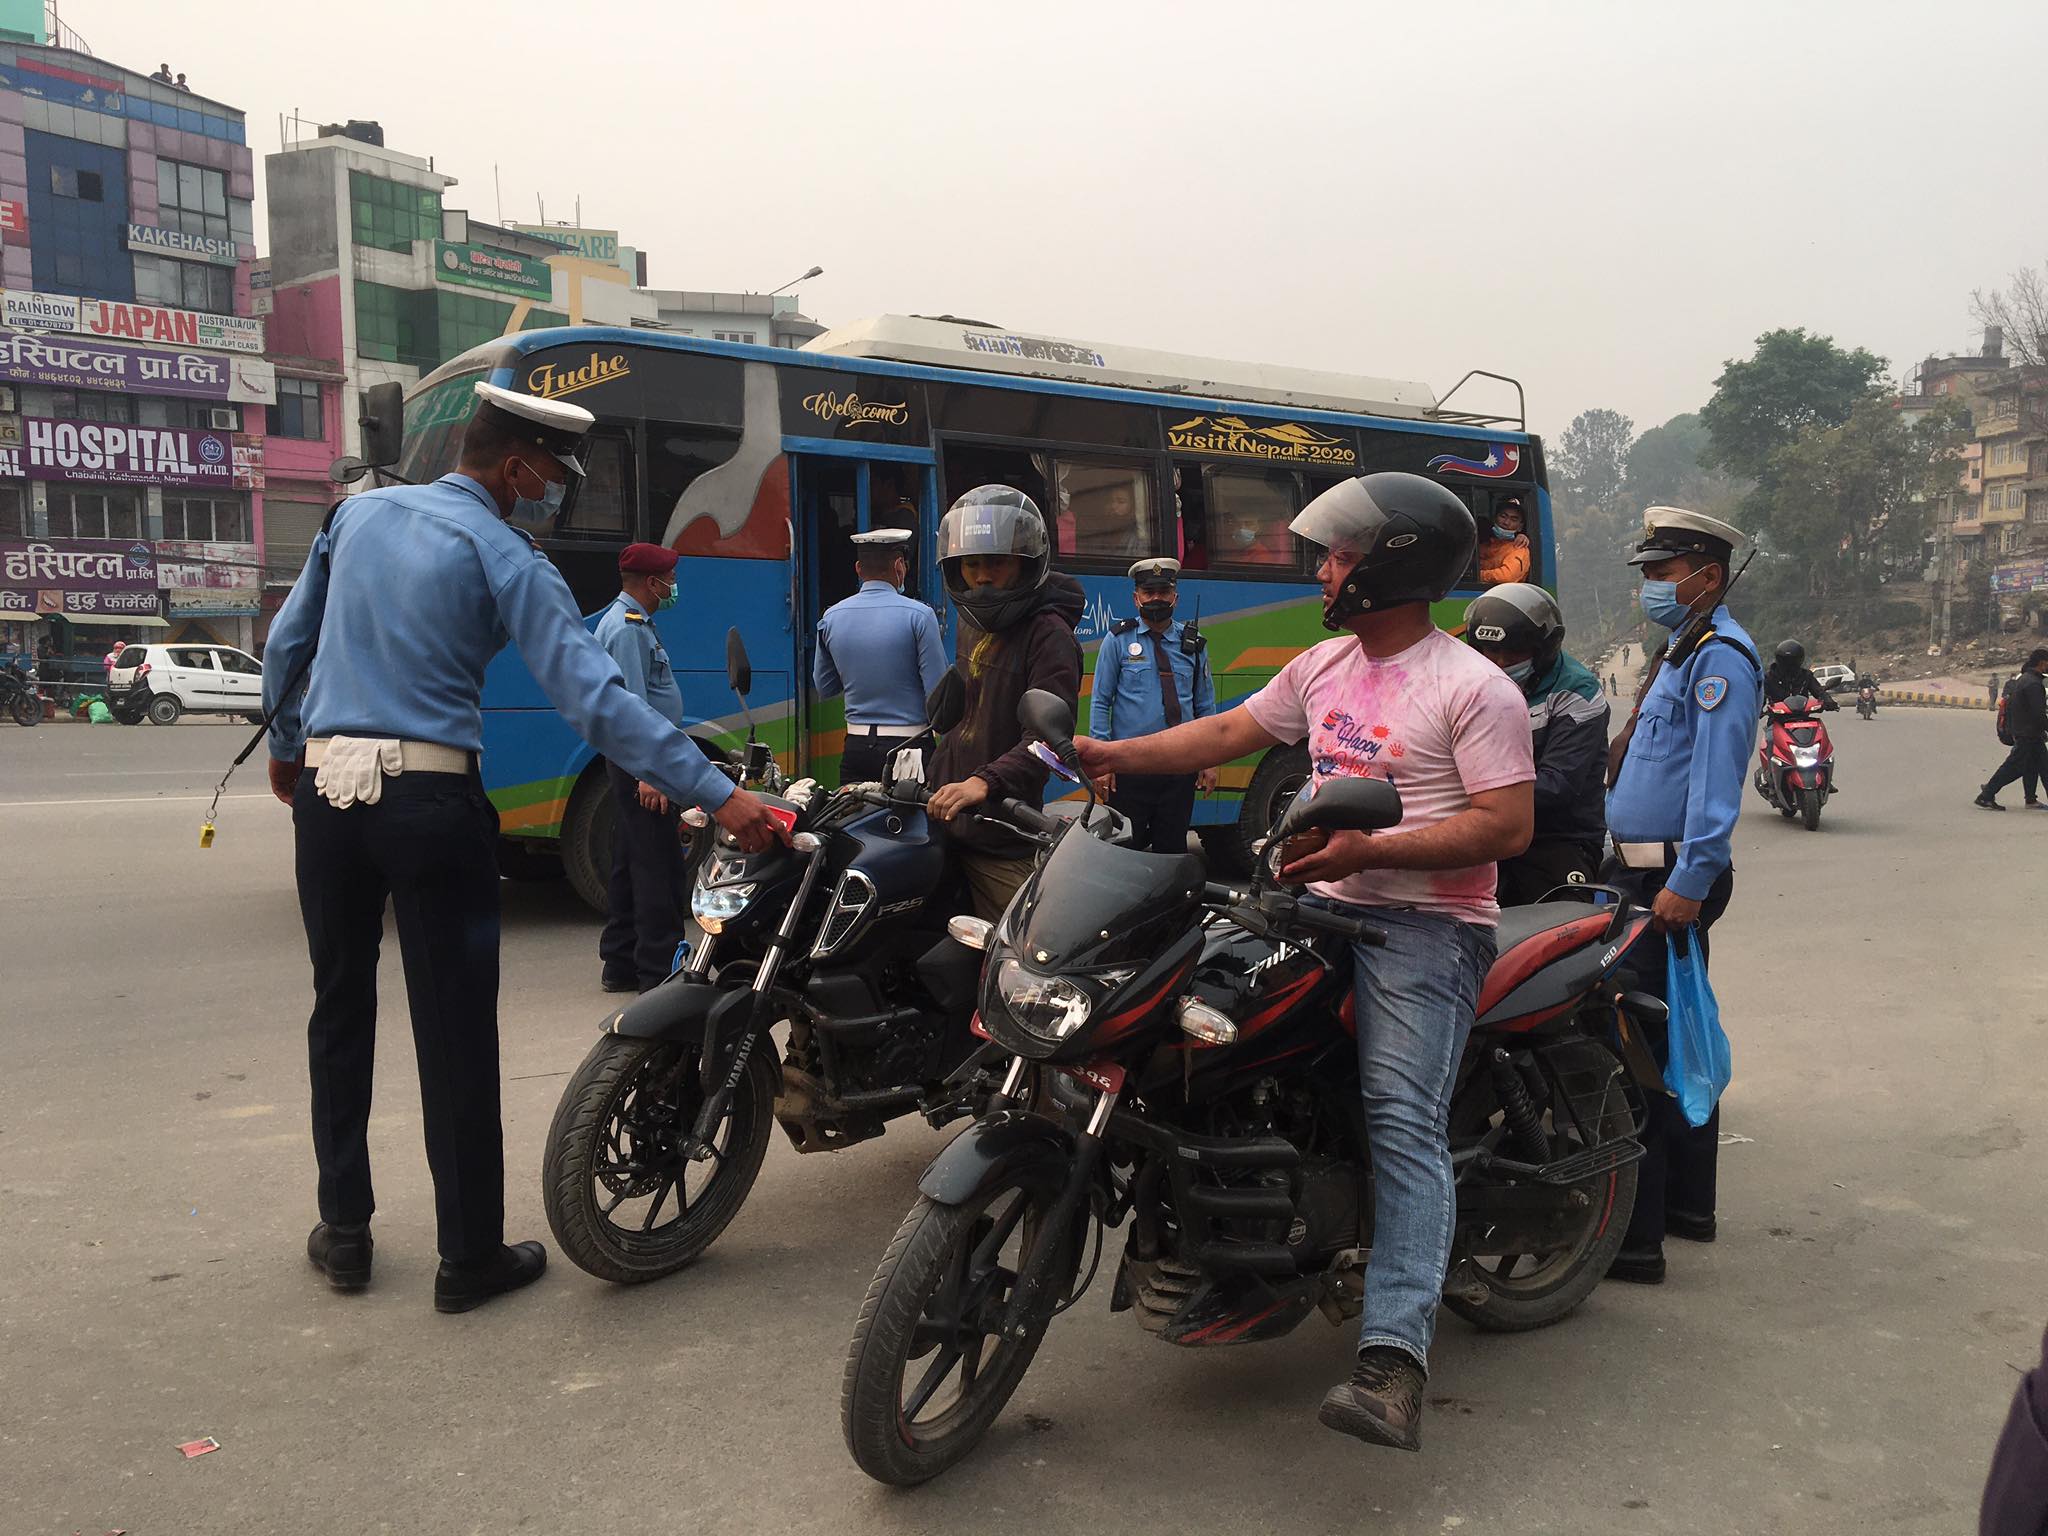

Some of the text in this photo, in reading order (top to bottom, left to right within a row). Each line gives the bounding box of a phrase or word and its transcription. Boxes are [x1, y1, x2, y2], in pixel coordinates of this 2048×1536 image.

[128, 224, 236, 257] KAKEHASHI
[7, 299, 75, 318] RAINBOW
[90, 302, 198, 345] JAPAN
[198, 315, 258, 331] AUSTRALIA/UK
[237, 341, 259, 351] CLASS
[802, 391, 908, 426] Welcome
[28, 420, 197, 474] HOSPITAL
[1239, 434, 1300, 459] Nepal
[1309, 445, 1356, 462] 2020
[4, 543, 125, 580] हस्पिटल
[1337, 722, 1382, 760] Happy
[1334, 751, 1371, 777] Holi
[1600, 946, 1618, 967] 150
[726, 1032, 757, 1088] YAMAHA
